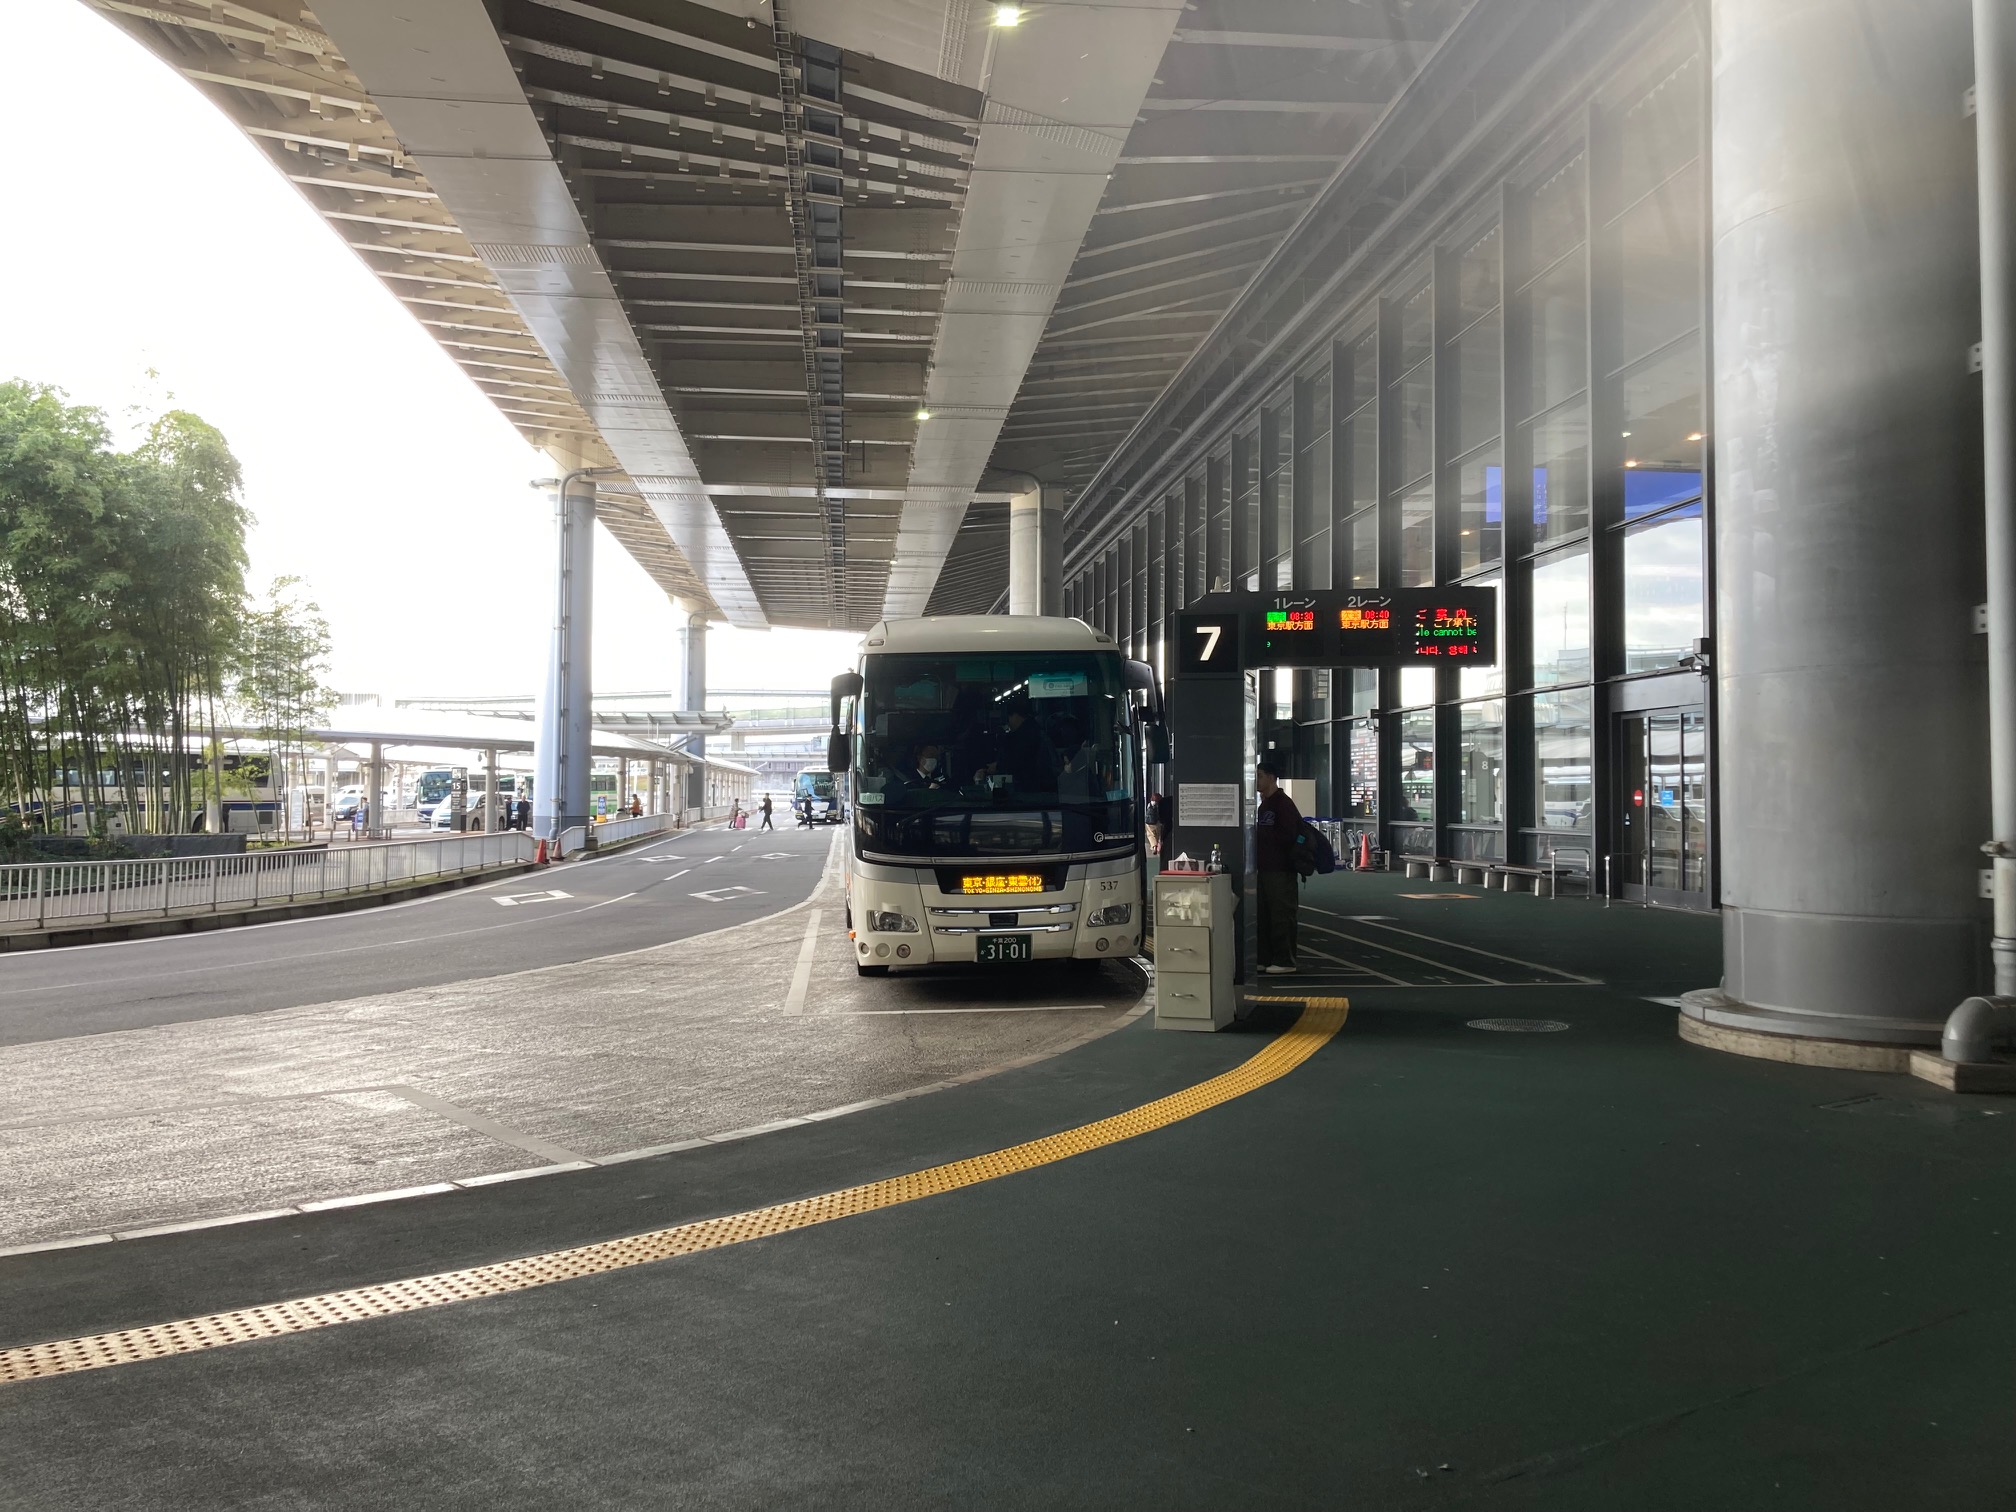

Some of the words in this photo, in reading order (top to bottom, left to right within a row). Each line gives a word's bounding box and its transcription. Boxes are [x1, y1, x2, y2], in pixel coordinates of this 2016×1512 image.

[1274, 598, 1316, 609] 1レーン
[1347, 596, 1391, 607] 2レーン
[1290, 612, 1314, 620] 08:30
[1365, 610, 1389, 619] 08:40
[1267, 621, 1313, 630] 東京駅方面
[1341, 619, 1389, 629] 東京駅方面
[1433, 627, 1463, 636] cannot
[1197, 627, 1221, 661] 7
[1101, 881, 1119, 891] 537
[987, 944, 1027, 960] 31-01
